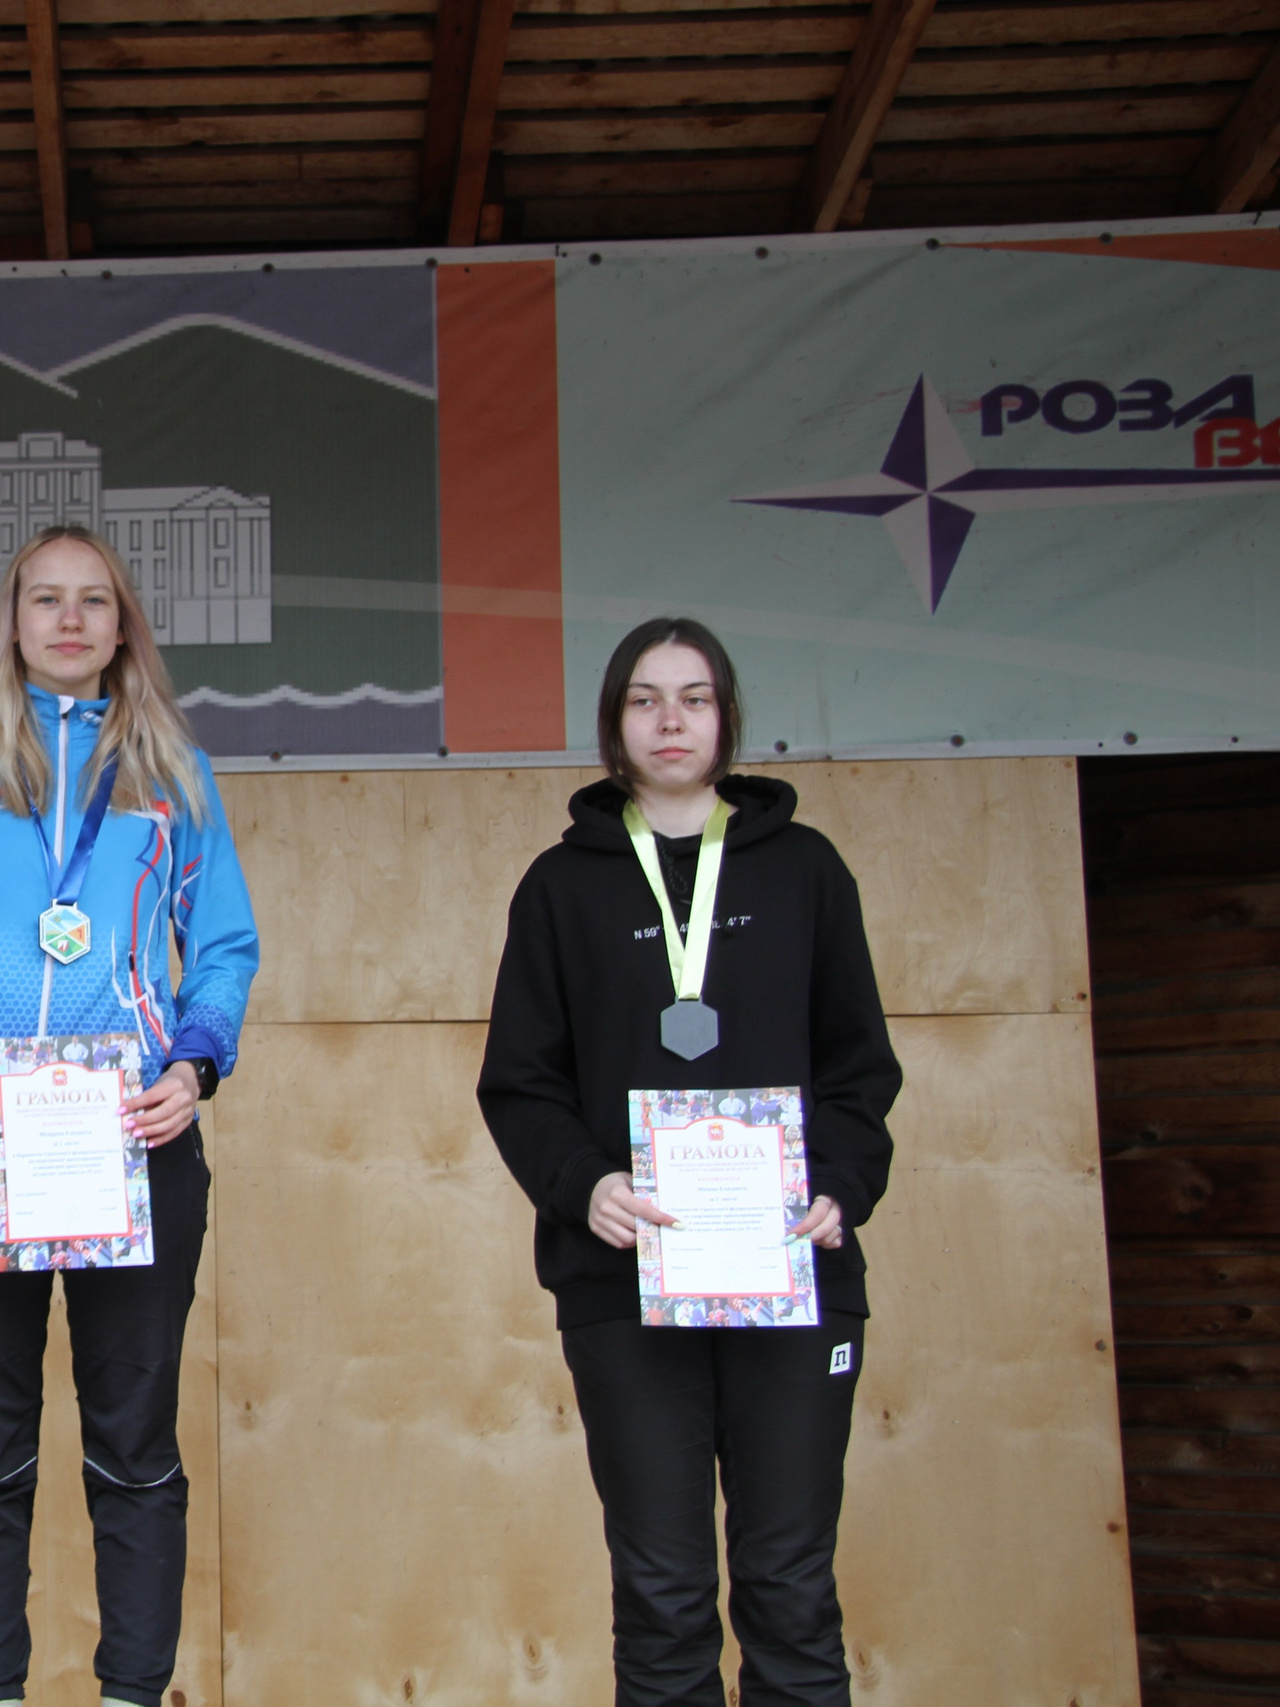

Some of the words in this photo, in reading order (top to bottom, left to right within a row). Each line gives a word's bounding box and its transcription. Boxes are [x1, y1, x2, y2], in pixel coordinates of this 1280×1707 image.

[980, 374, 1256, 436] РОЗА
[15, 1088, 107, 1106] ГРАМОТА
[669, 1143, 767, 1161] ГРАМОТА
